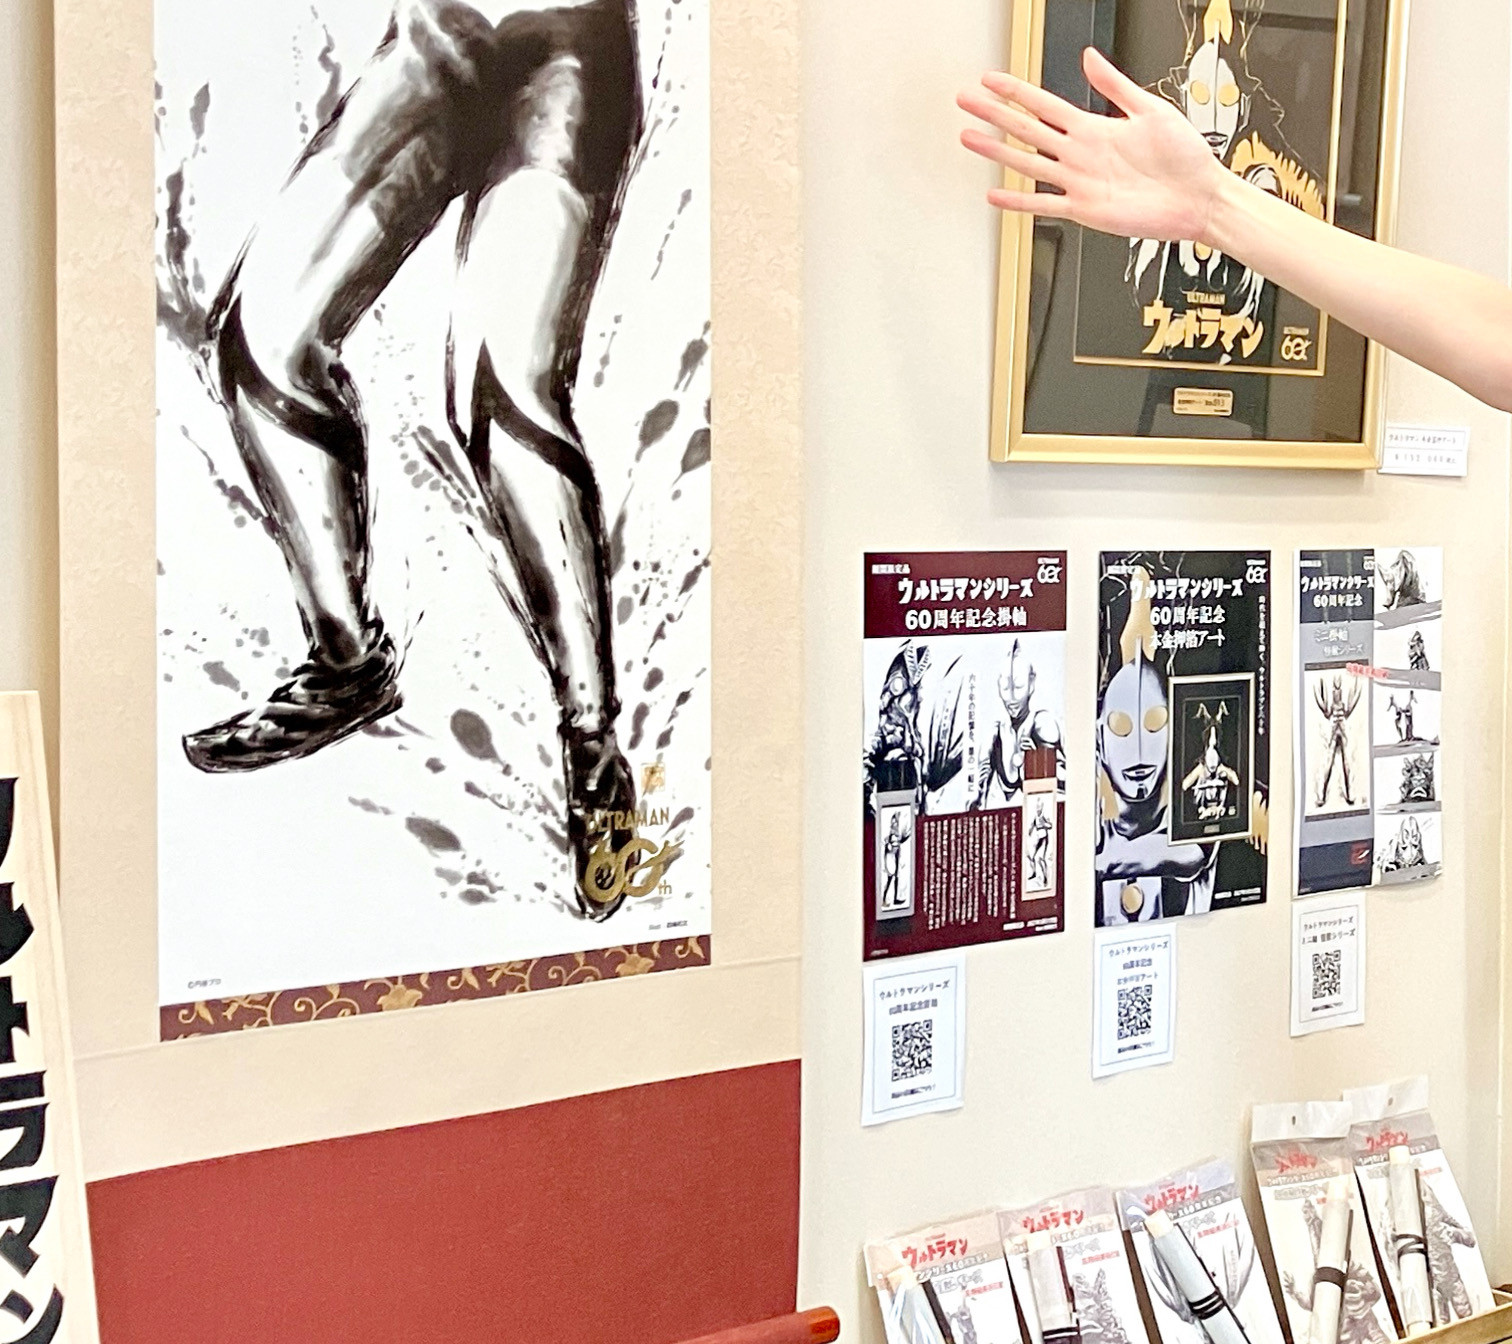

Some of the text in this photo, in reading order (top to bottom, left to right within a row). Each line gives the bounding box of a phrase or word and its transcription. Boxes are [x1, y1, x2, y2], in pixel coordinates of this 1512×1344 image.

[1142, 299, 1264, 359] ウルトラマン
[898, 577, 1034, 605] ウルトラマンシリーズ
[1130, 578, 1243, 603] ウルトラマンシリーズ
[1313, 593, 1363, 608] 60周年記念
[905, 606, 1027, 630] 60周年記念掛軸
[1150, 604, 1226, 625] 60周年記念
[901, 1238, 968, 1270] ウルトラマン
